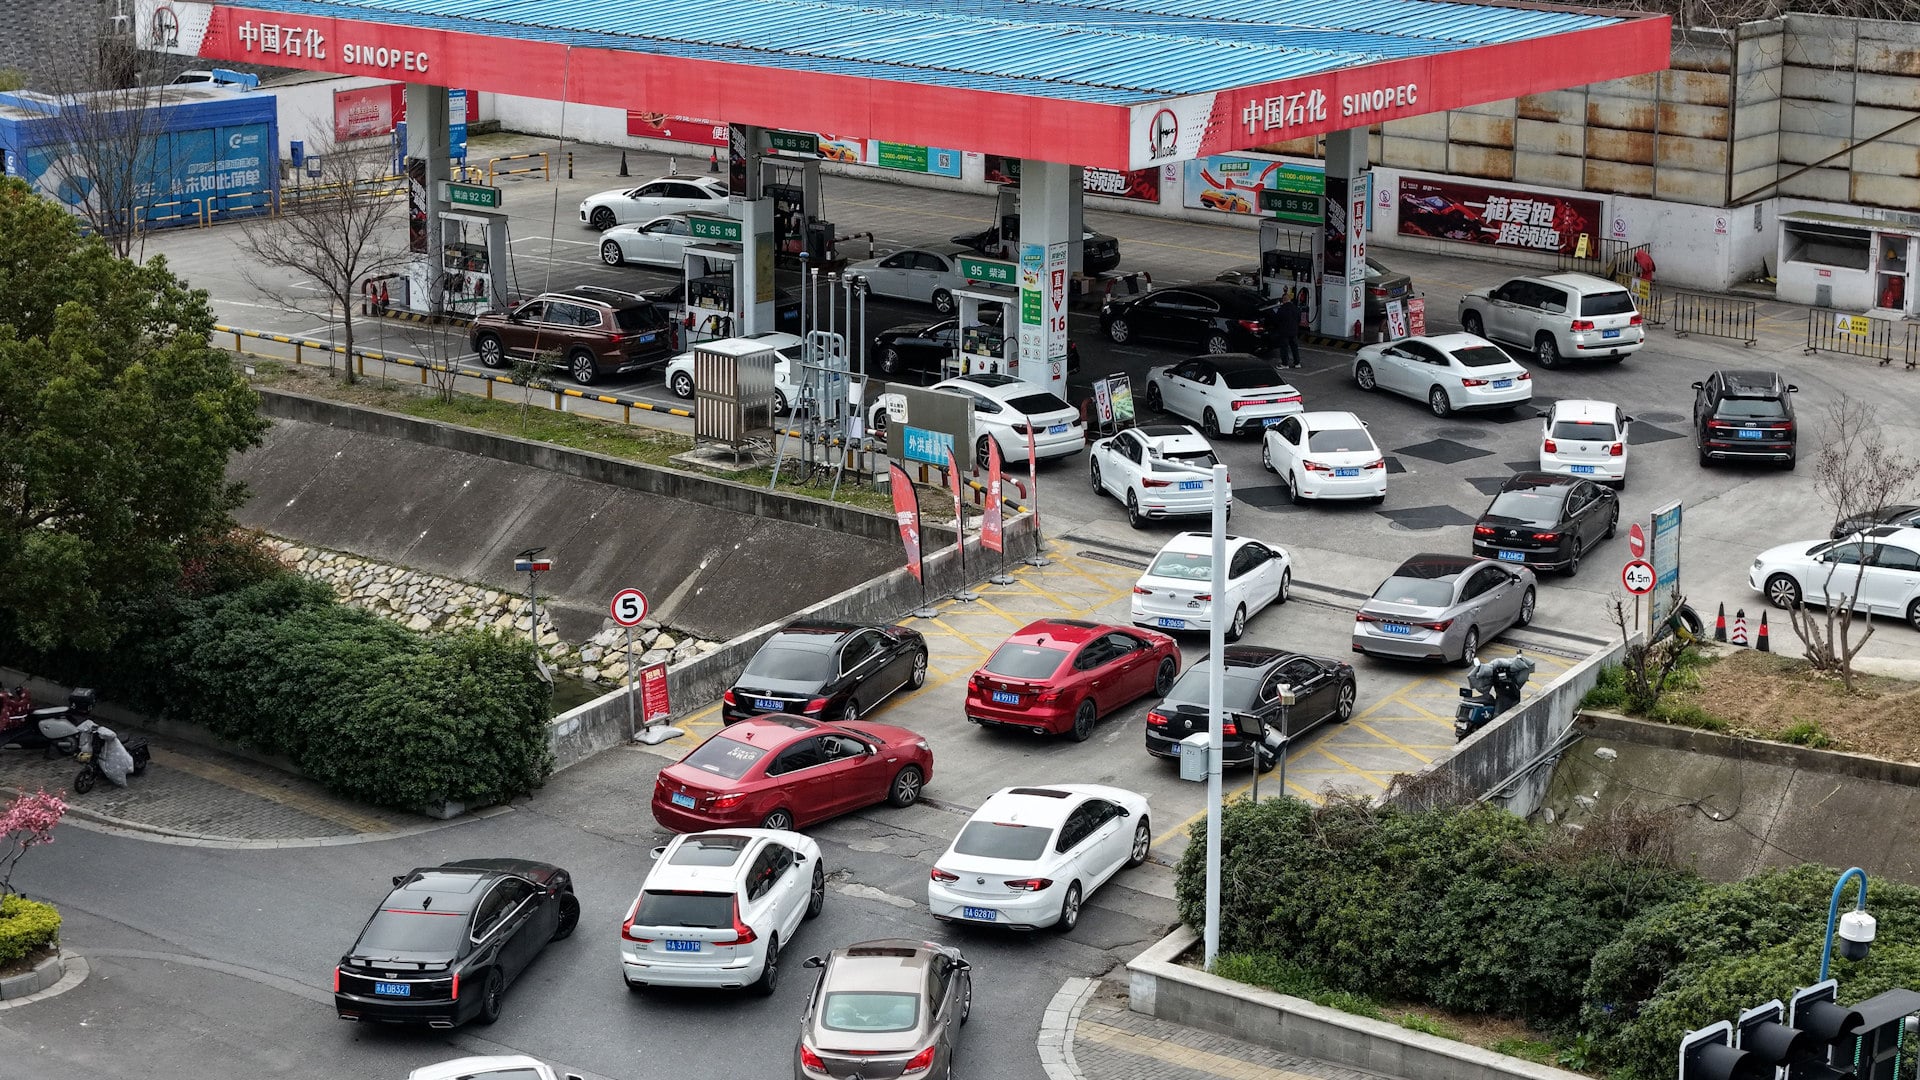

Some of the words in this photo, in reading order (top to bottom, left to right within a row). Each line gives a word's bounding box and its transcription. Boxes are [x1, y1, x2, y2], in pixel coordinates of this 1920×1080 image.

[238, 19, 326, 60] 中国石化
[343, 43, 430, 74] SINOPEC
[1342, 83, 1418, 117] SINOPEC
[1242, 88, 1327, 135] 中国石化
[787, 139, 796, 148] 95
[800, 140, 810, 149] 92
[469, 192, 479, 202] 92
[481, 194, 492, 203] 92
[1286, 200, 1298, 210] 95
[1302, 201, 1314, 211] 92
[1463, 194, 1556, 227] 一箱爱跑
[695, 223, 706, 234] 92
[710, 225, 721, 236] 95
[1480, 221, 1562, 250] 一路领跑
[970, 264, 983, 276] 95
[1626, 571, 1650, 583] 4.5m
[622, 597, 638, 619] 5
